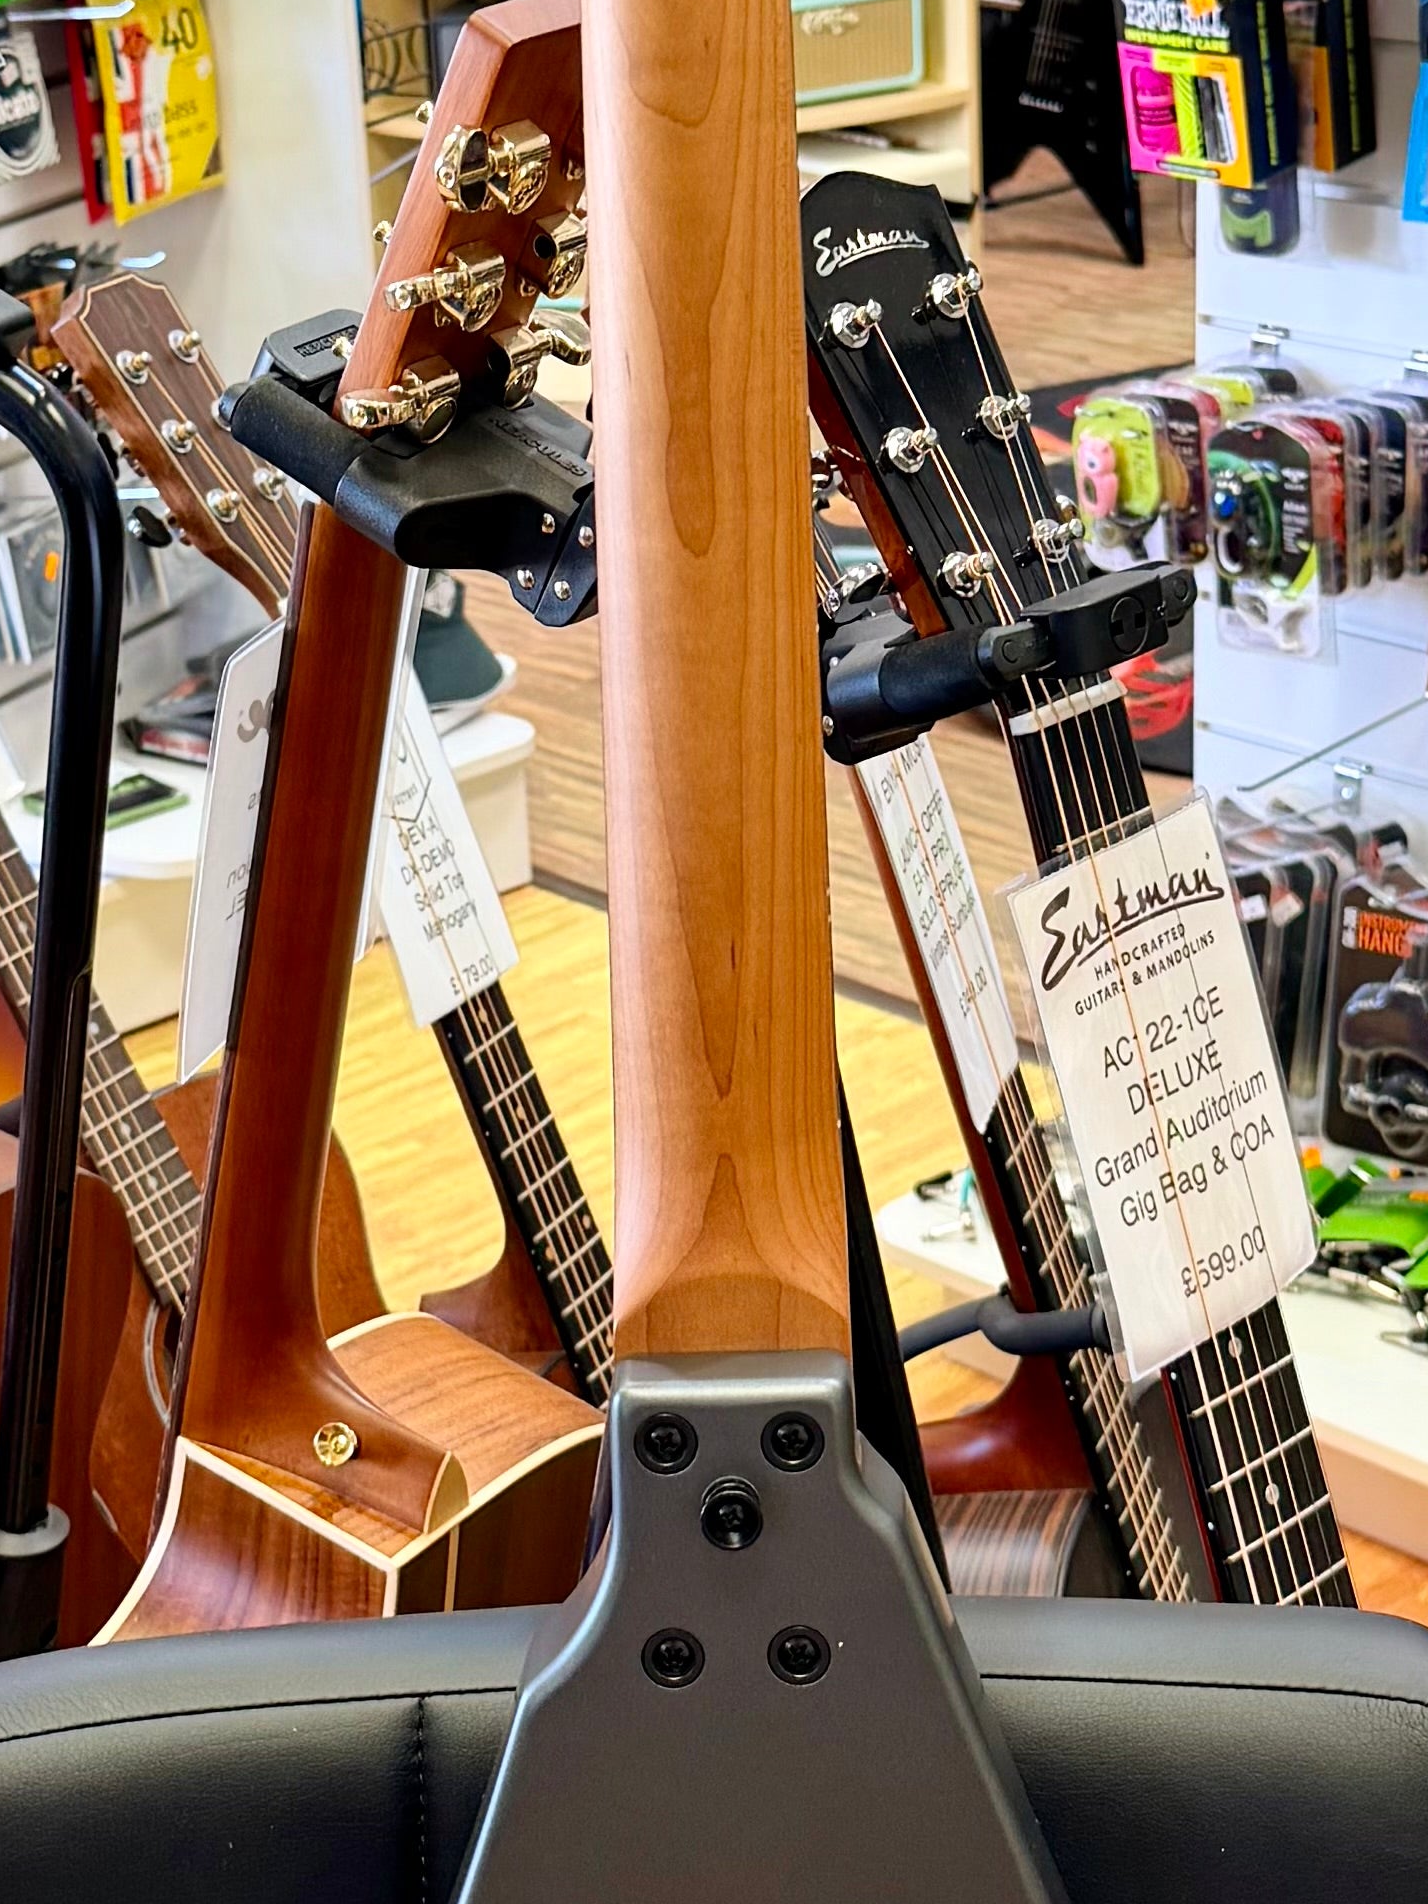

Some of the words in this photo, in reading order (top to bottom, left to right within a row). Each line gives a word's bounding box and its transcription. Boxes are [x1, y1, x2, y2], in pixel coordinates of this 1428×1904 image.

[161, 8, 199, 53] 40
[1124, 28, 1194, 52] INSTRUMENT
[1195, 38, 1230, 54] CARE
[812, 226, 930, 278] Eastman
[1040, 853, 1225, 992] Eastman
[1094, 922, 1186, 981] HANDCRAFTED
[1357, 925, 1413, 959] HANG
[1074, 977, 1126, 1017] GUITARS
[1131, 970, 1143, 986] &
[1146, 930, 1215, 981] MANDOLINS
[1102, 985, 1224, 1078] AC22-1CE
[1127, 1039, 1222, 1115] DELUXE
[1094, 1127, 1160, 1188] Grand
[1165, 1069, 1268, 1150] Auditorium
[1120, 1189, 1159, 1227] Gig
[1159, 1162, 1209, 1204] Bag
[1211, 1144, 1229, 1175] &
[1230, 1113, 1276, 1162] COA
[1180, 1224, 1267, 1299] £599.00
